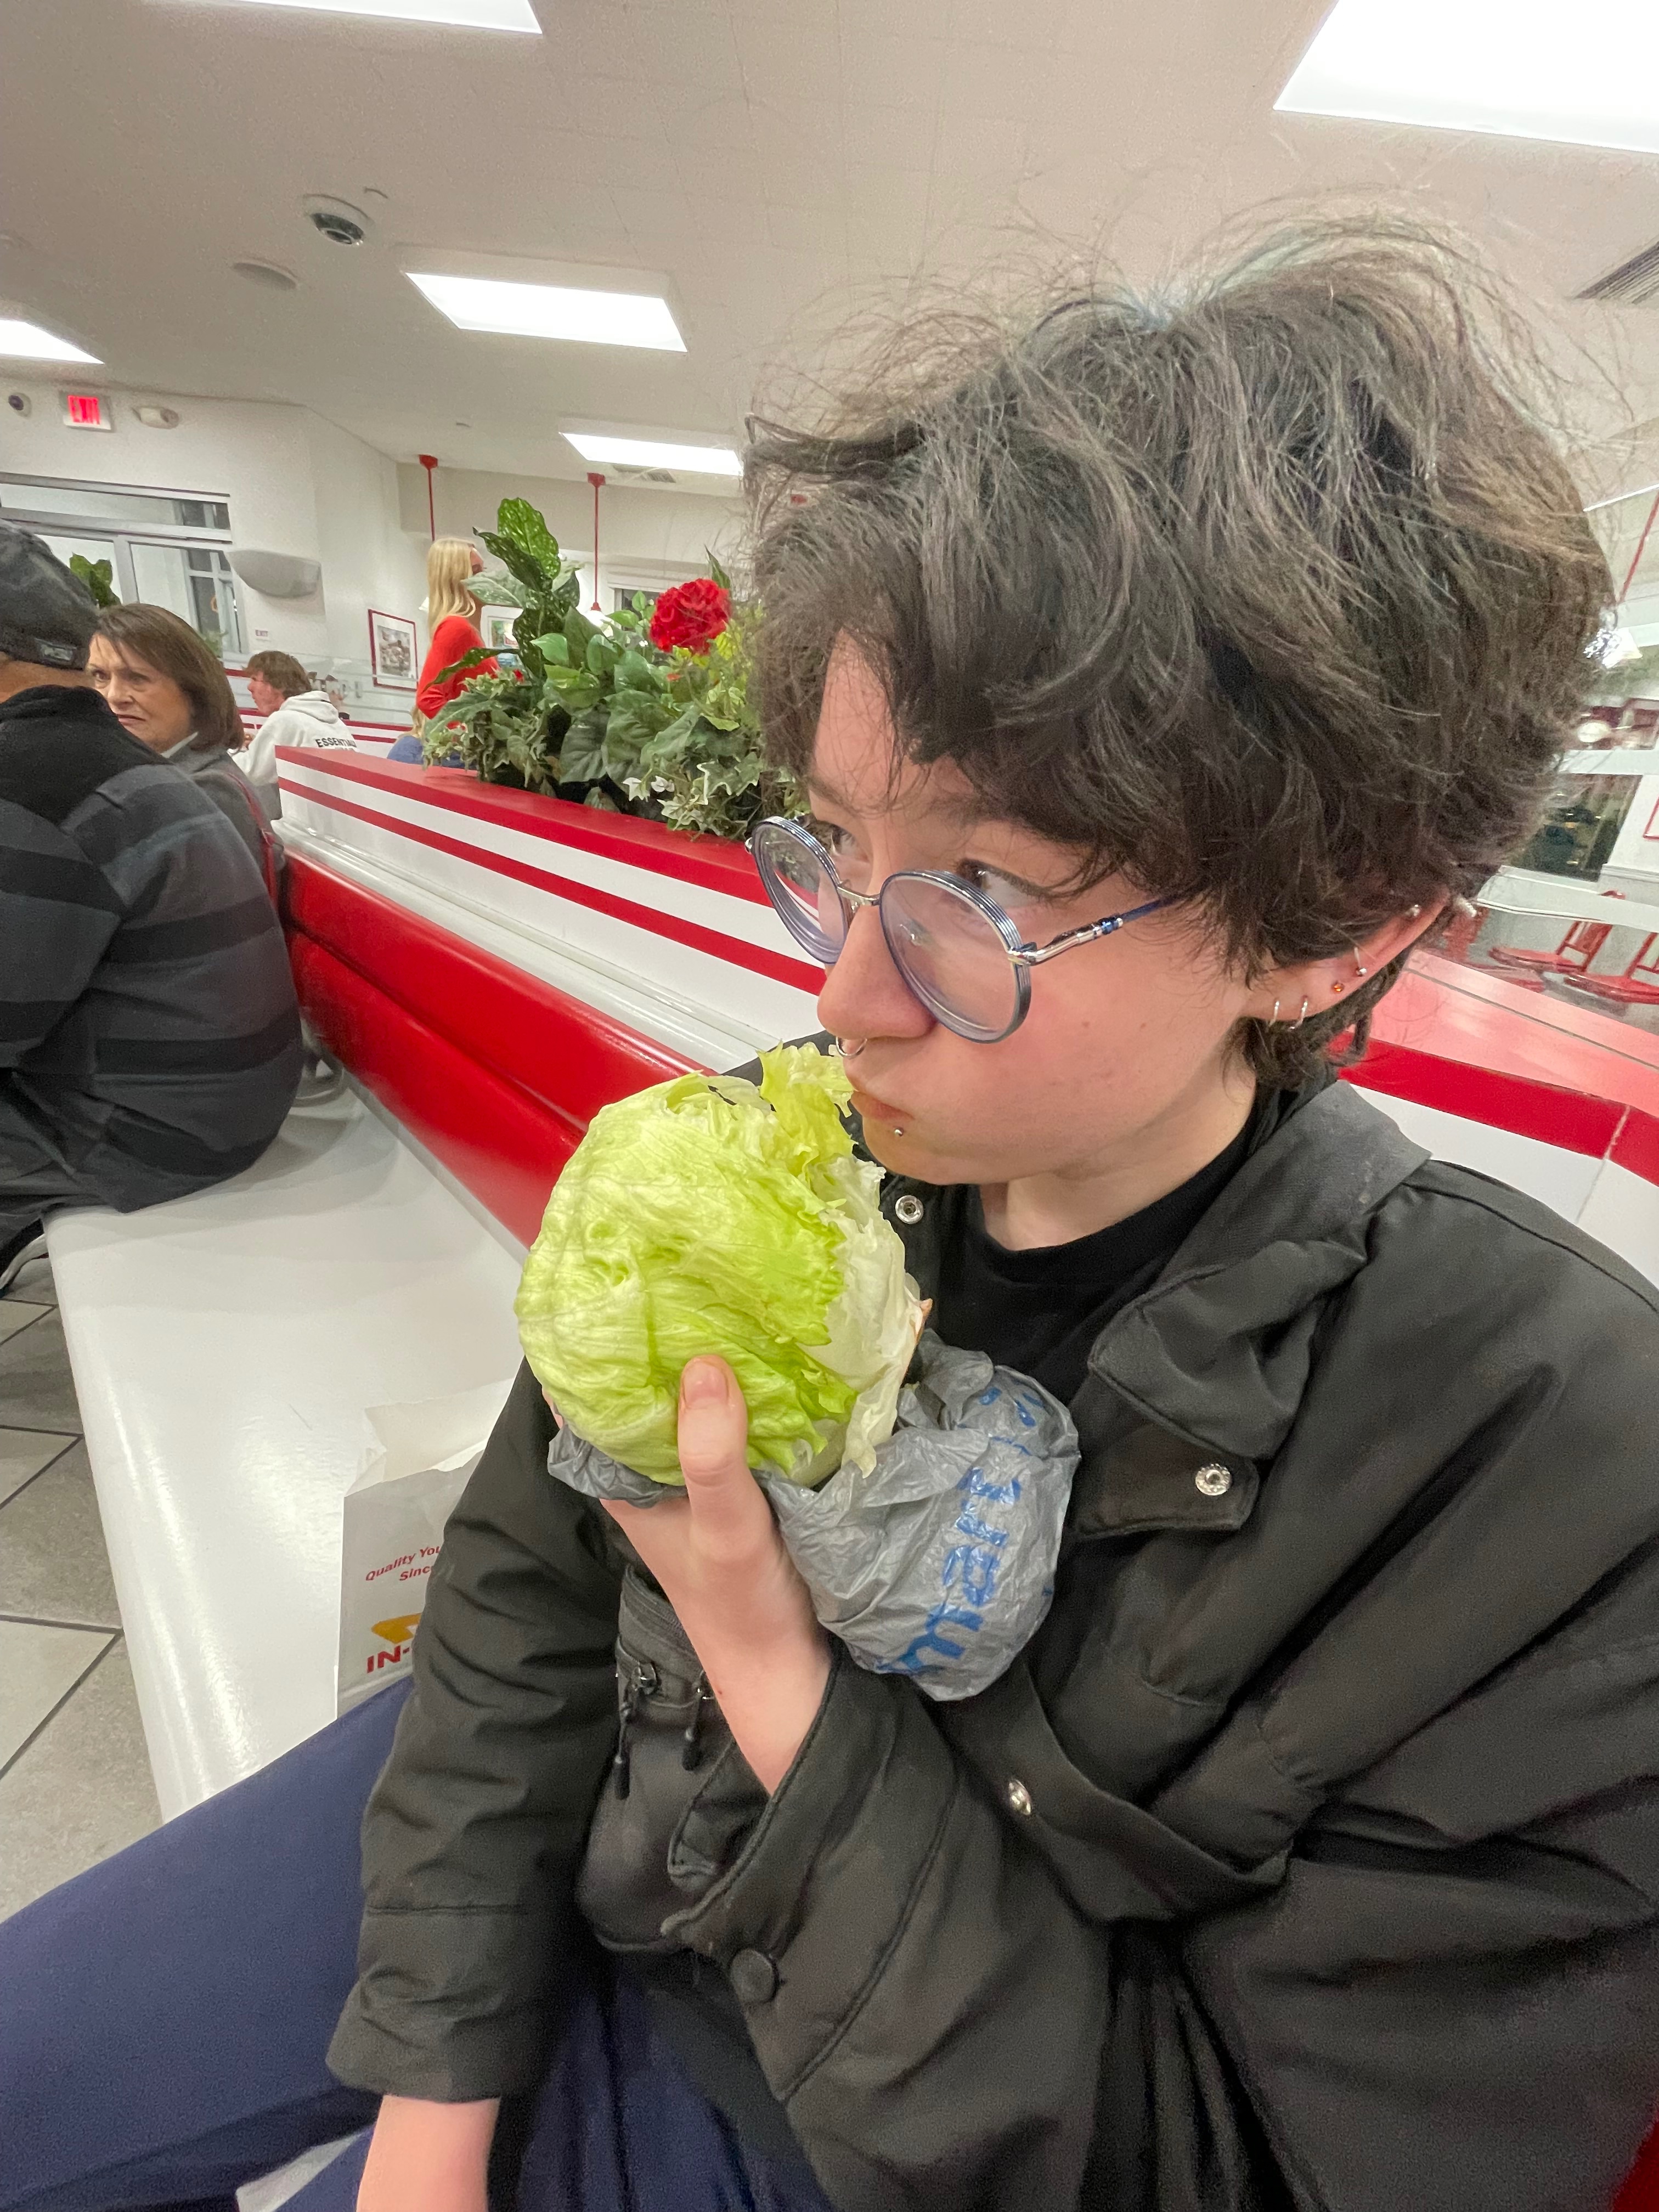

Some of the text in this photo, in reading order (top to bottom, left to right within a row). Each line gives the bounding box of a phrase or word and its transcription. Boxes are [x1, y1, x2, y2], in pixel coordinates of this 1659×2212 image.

[68, 395, 100, 425] EXIT
[365, 1553, 417, 1581] Quality
[399, 1565, 431, 1581] Sinc
[366, 1645, 410, 1673] IN-
